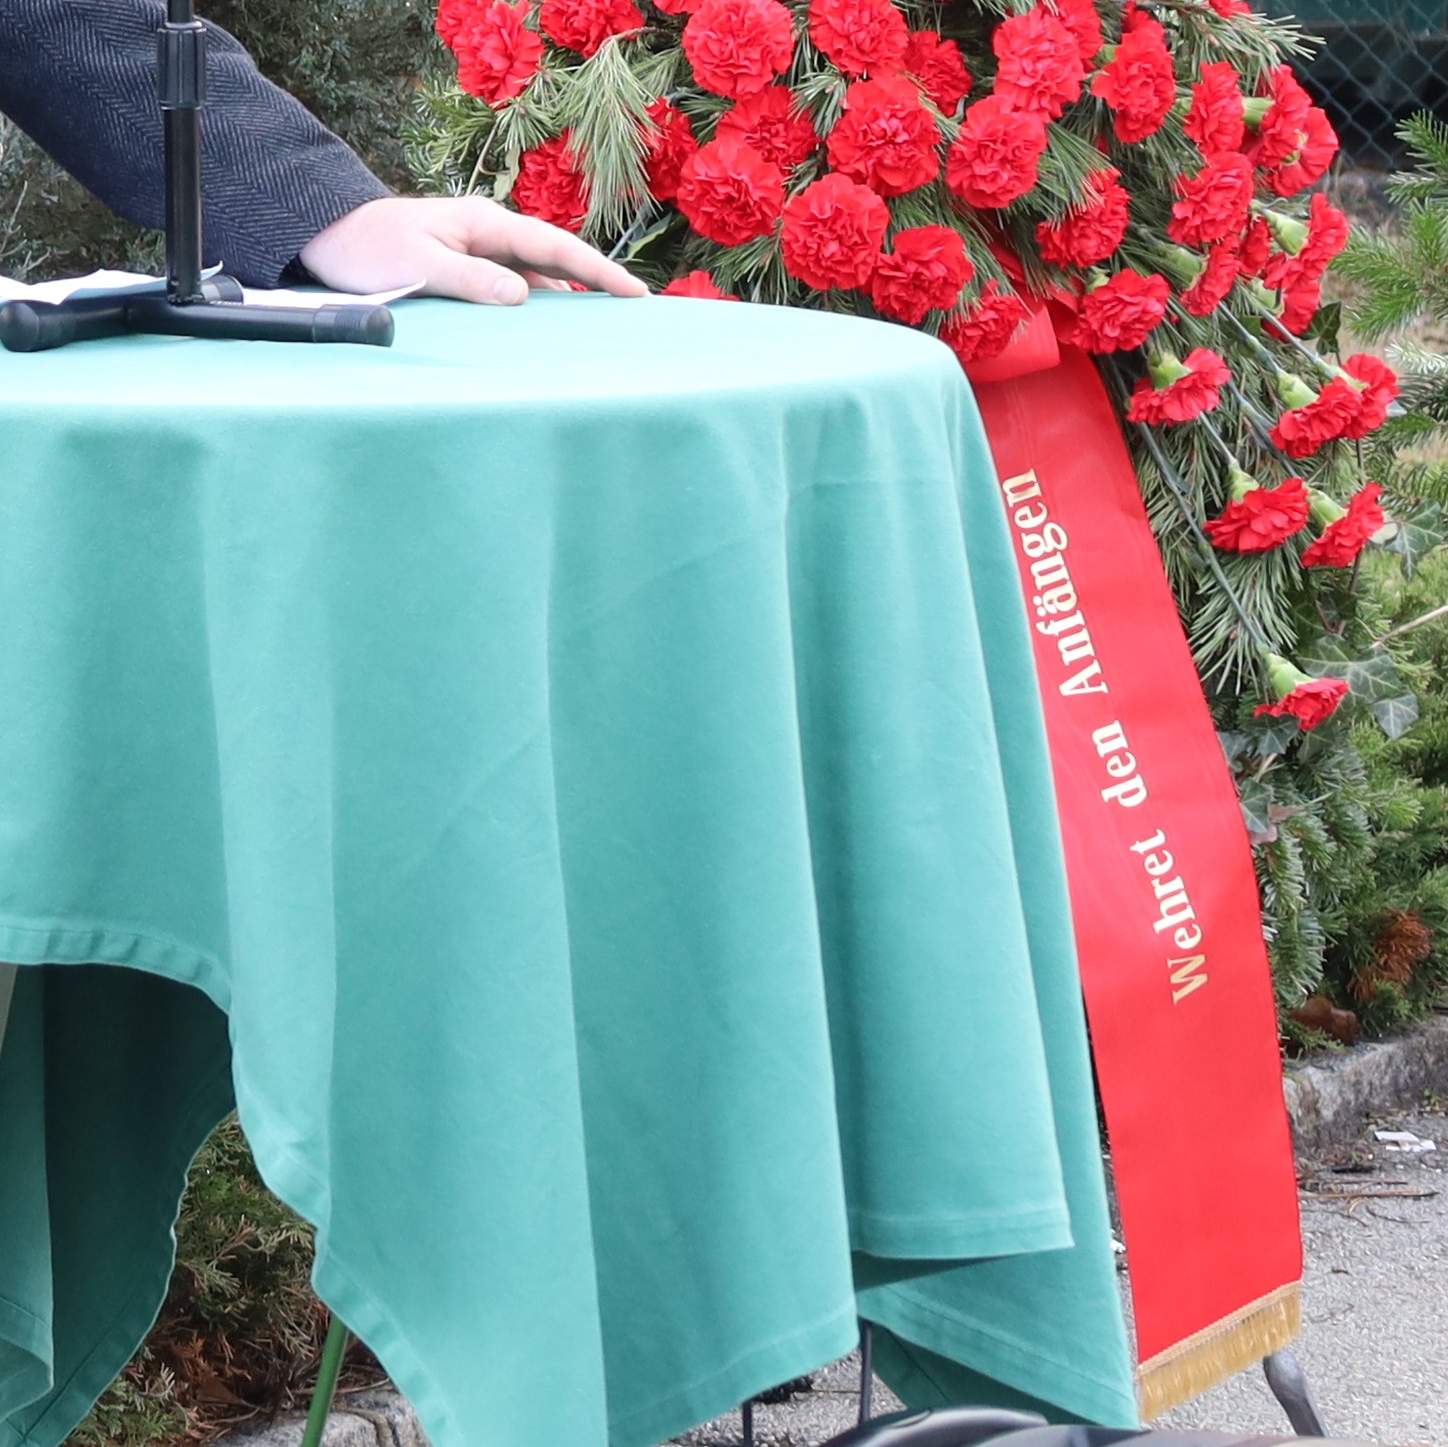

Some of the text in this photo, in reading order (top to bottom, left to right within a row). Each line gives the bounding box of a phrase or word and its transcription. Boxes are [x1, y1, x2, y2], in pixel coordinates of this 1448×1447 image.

[1002, 467, 1208, 1005] Wehret den Anfängen
